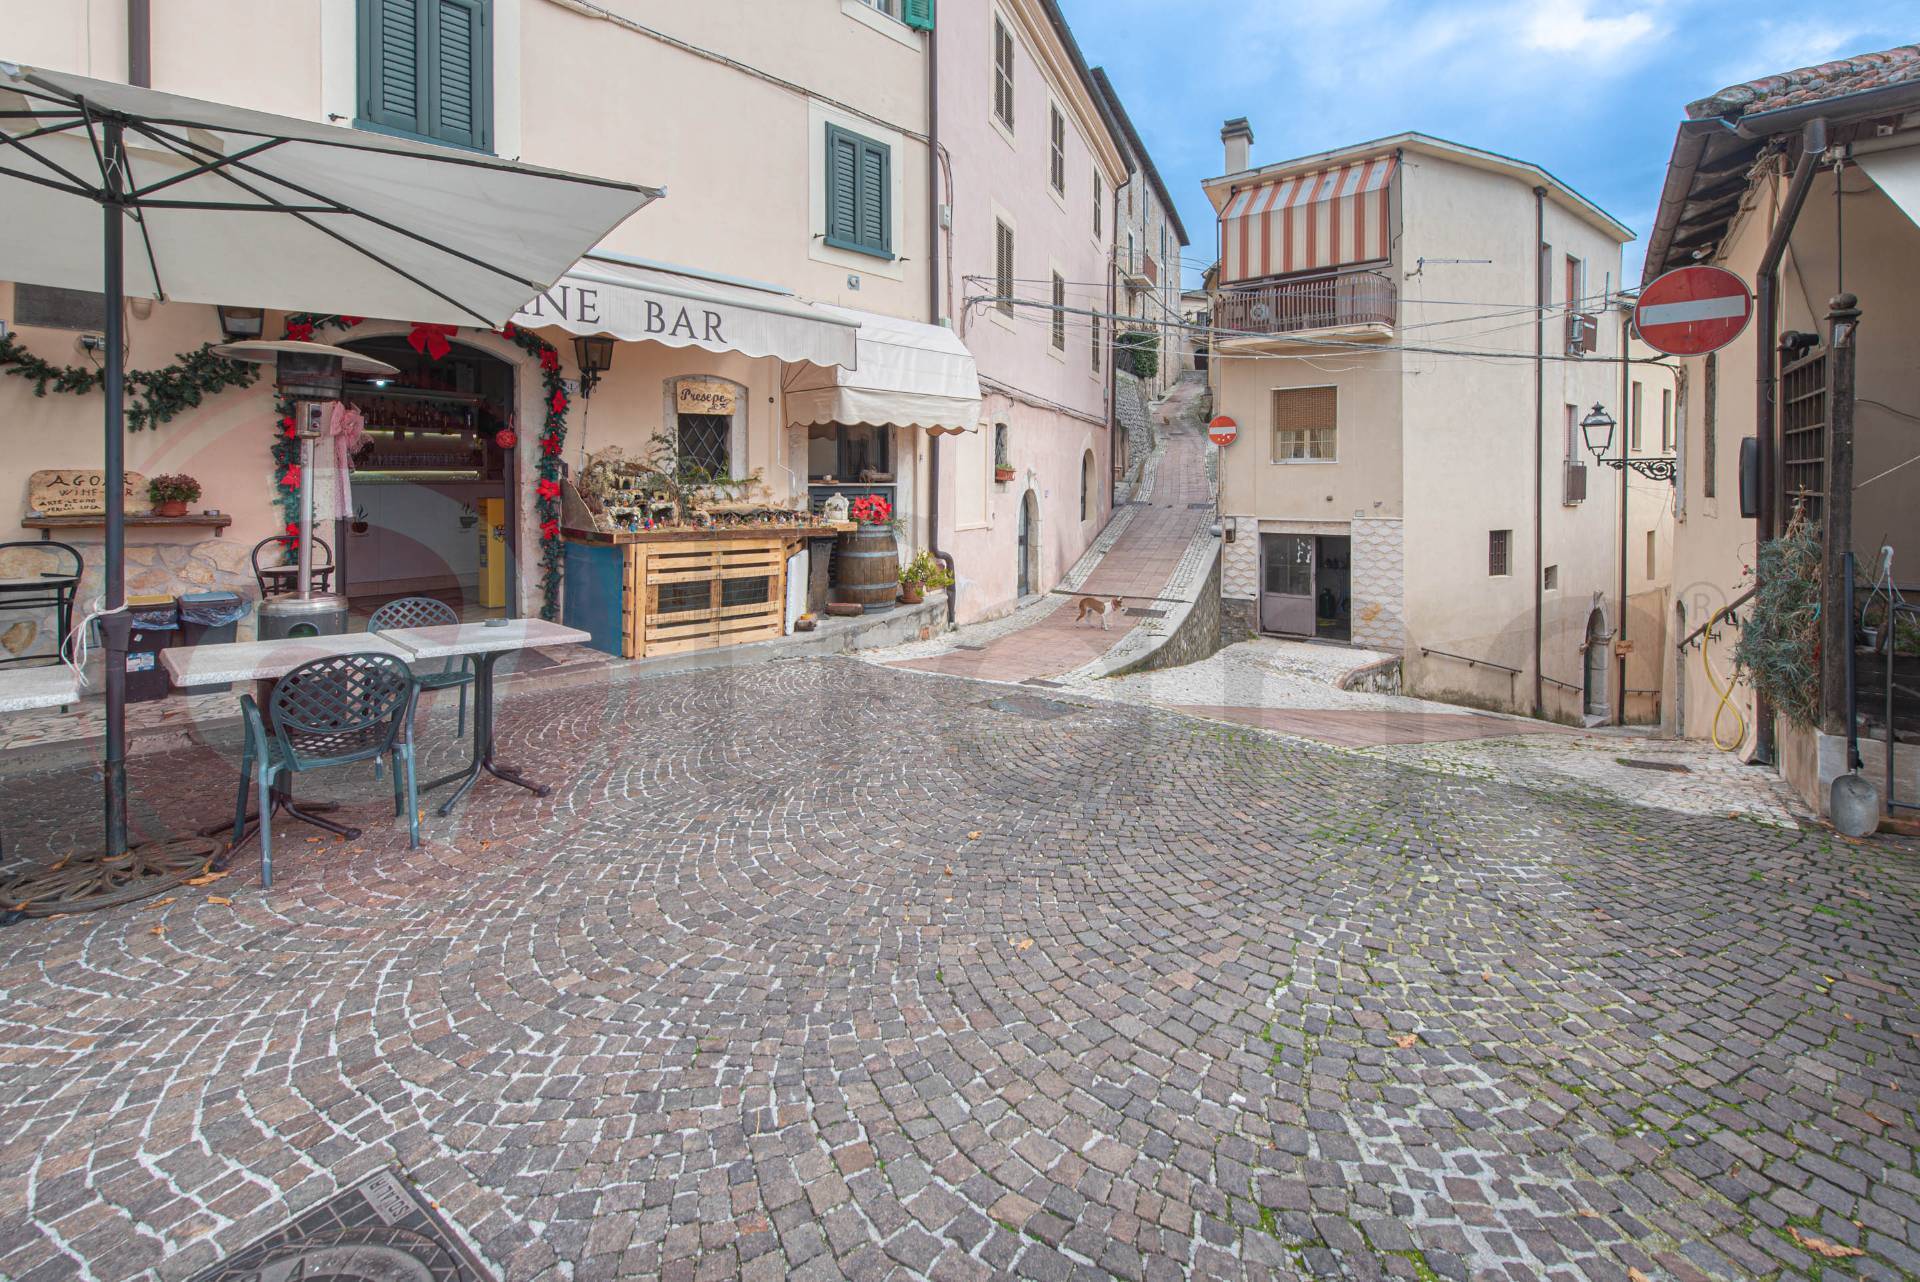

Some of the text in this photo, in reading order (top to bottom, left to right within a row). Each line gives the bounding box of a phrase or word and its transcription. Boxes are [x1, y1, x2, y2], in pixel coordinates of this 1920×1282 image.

[644, 300, 727, 343] BAR
[680, 388, 728, 406] Presepe
[46, 472, 133, 487] AGO
